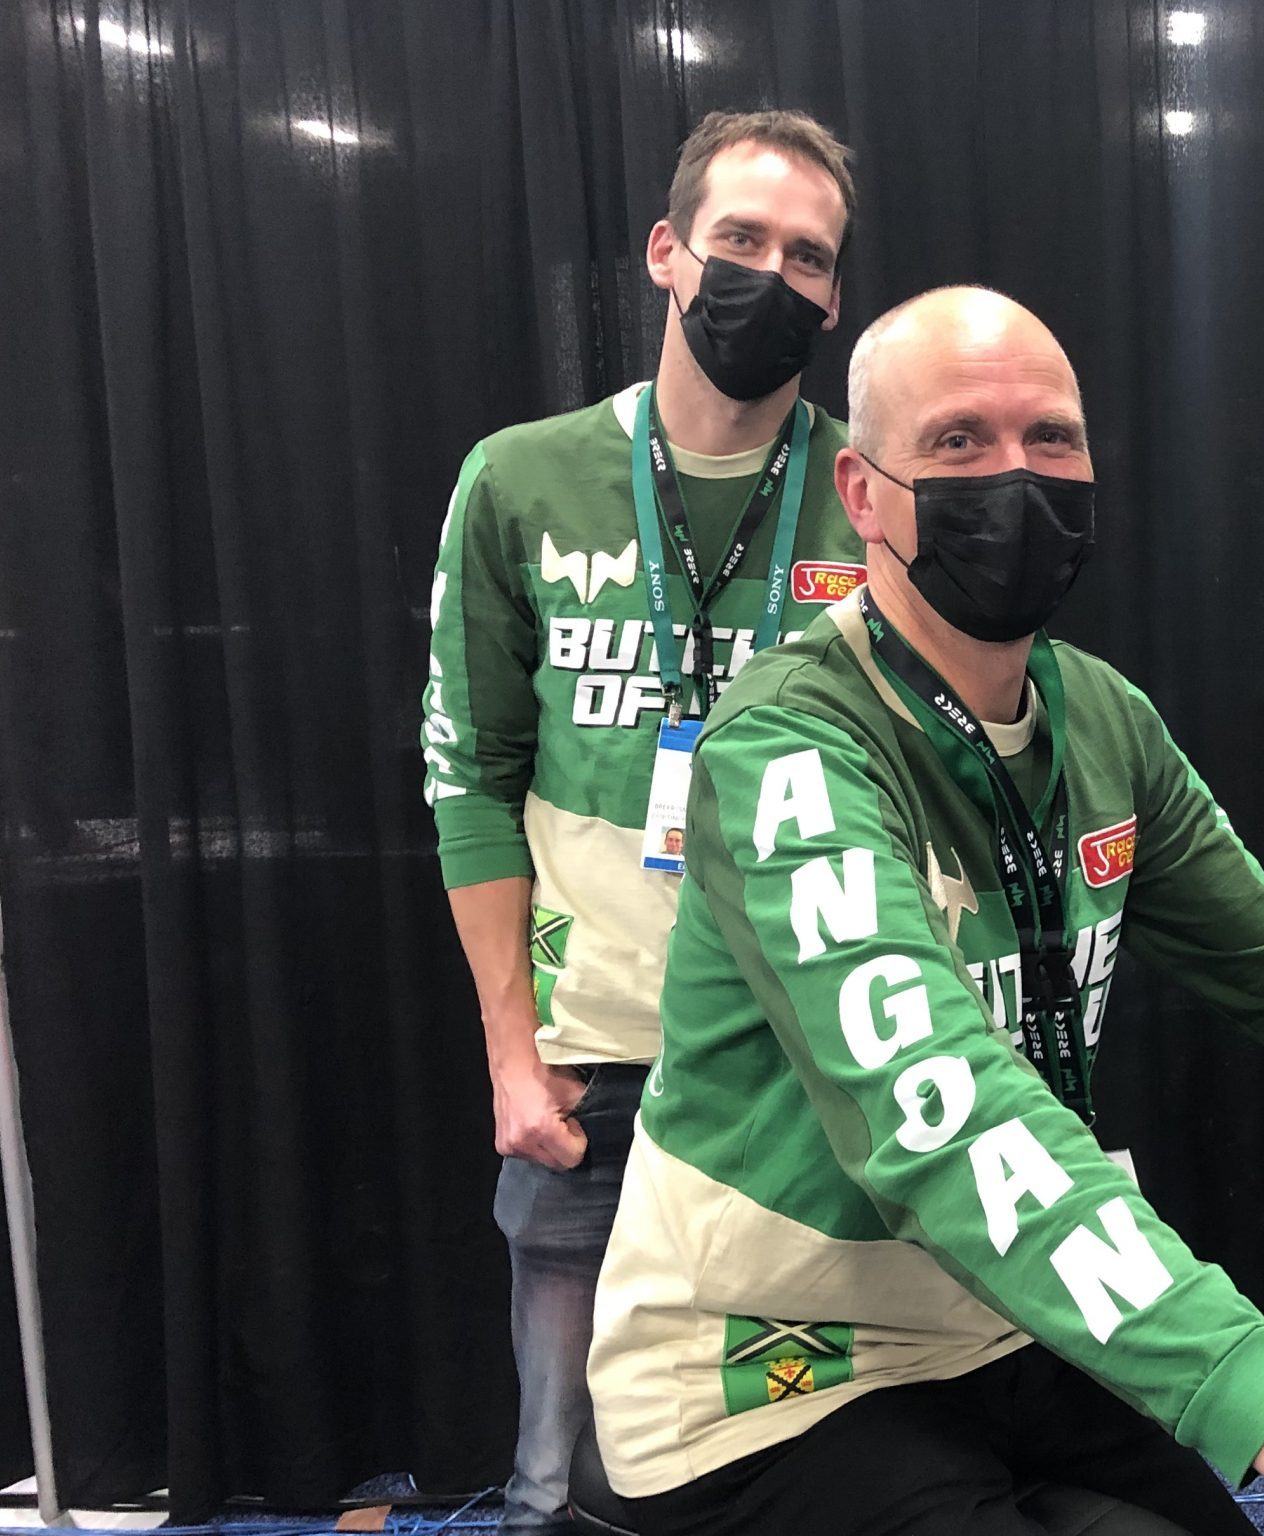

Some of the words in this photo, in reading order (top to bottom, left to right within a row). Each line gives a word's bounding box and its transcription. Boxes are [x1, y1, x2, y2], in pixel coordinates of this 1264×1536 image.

[649, 560, 665, 611] SONY
[767, 564, 784, 614] SONY
[814, 572, 857, 588] Race
[571, 674, 667, 730] OF
